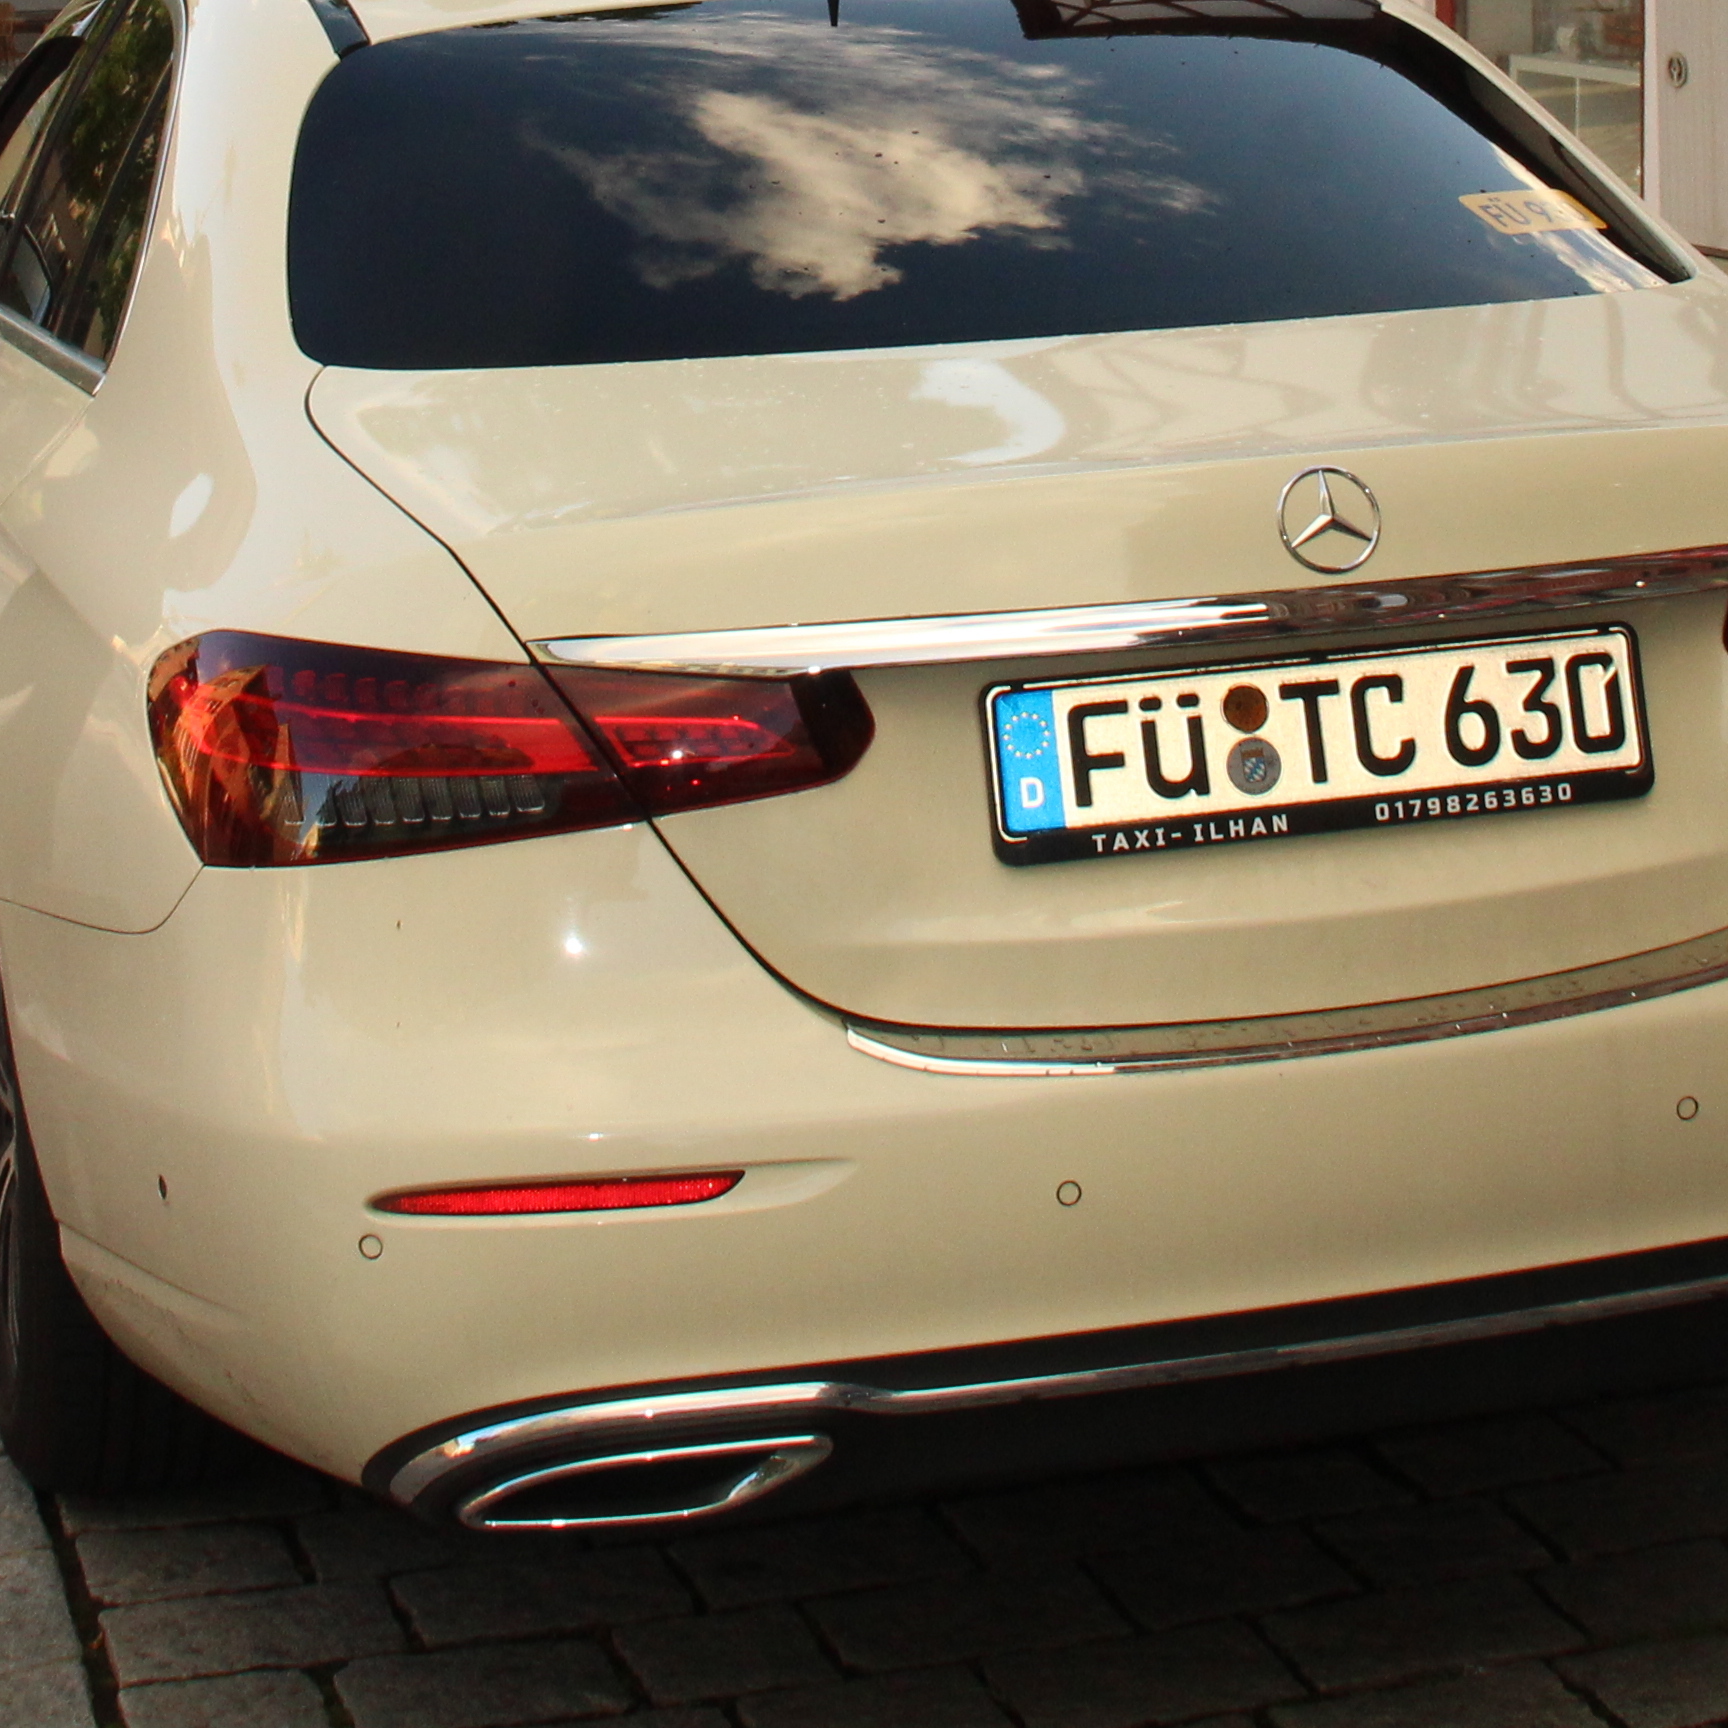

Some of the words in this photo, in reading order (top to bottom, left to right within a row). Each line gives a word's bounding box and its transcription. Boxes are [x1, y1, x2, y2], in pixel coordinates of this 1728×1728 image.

[1020, 776, 1045, 809] D
[1067, 696, 1211, 808] FÜ
[1278, 674, 1417, 783] TC
[1444, 652, 1629, 768] 630
[1375, 783, 1571, 821] 01798263630
